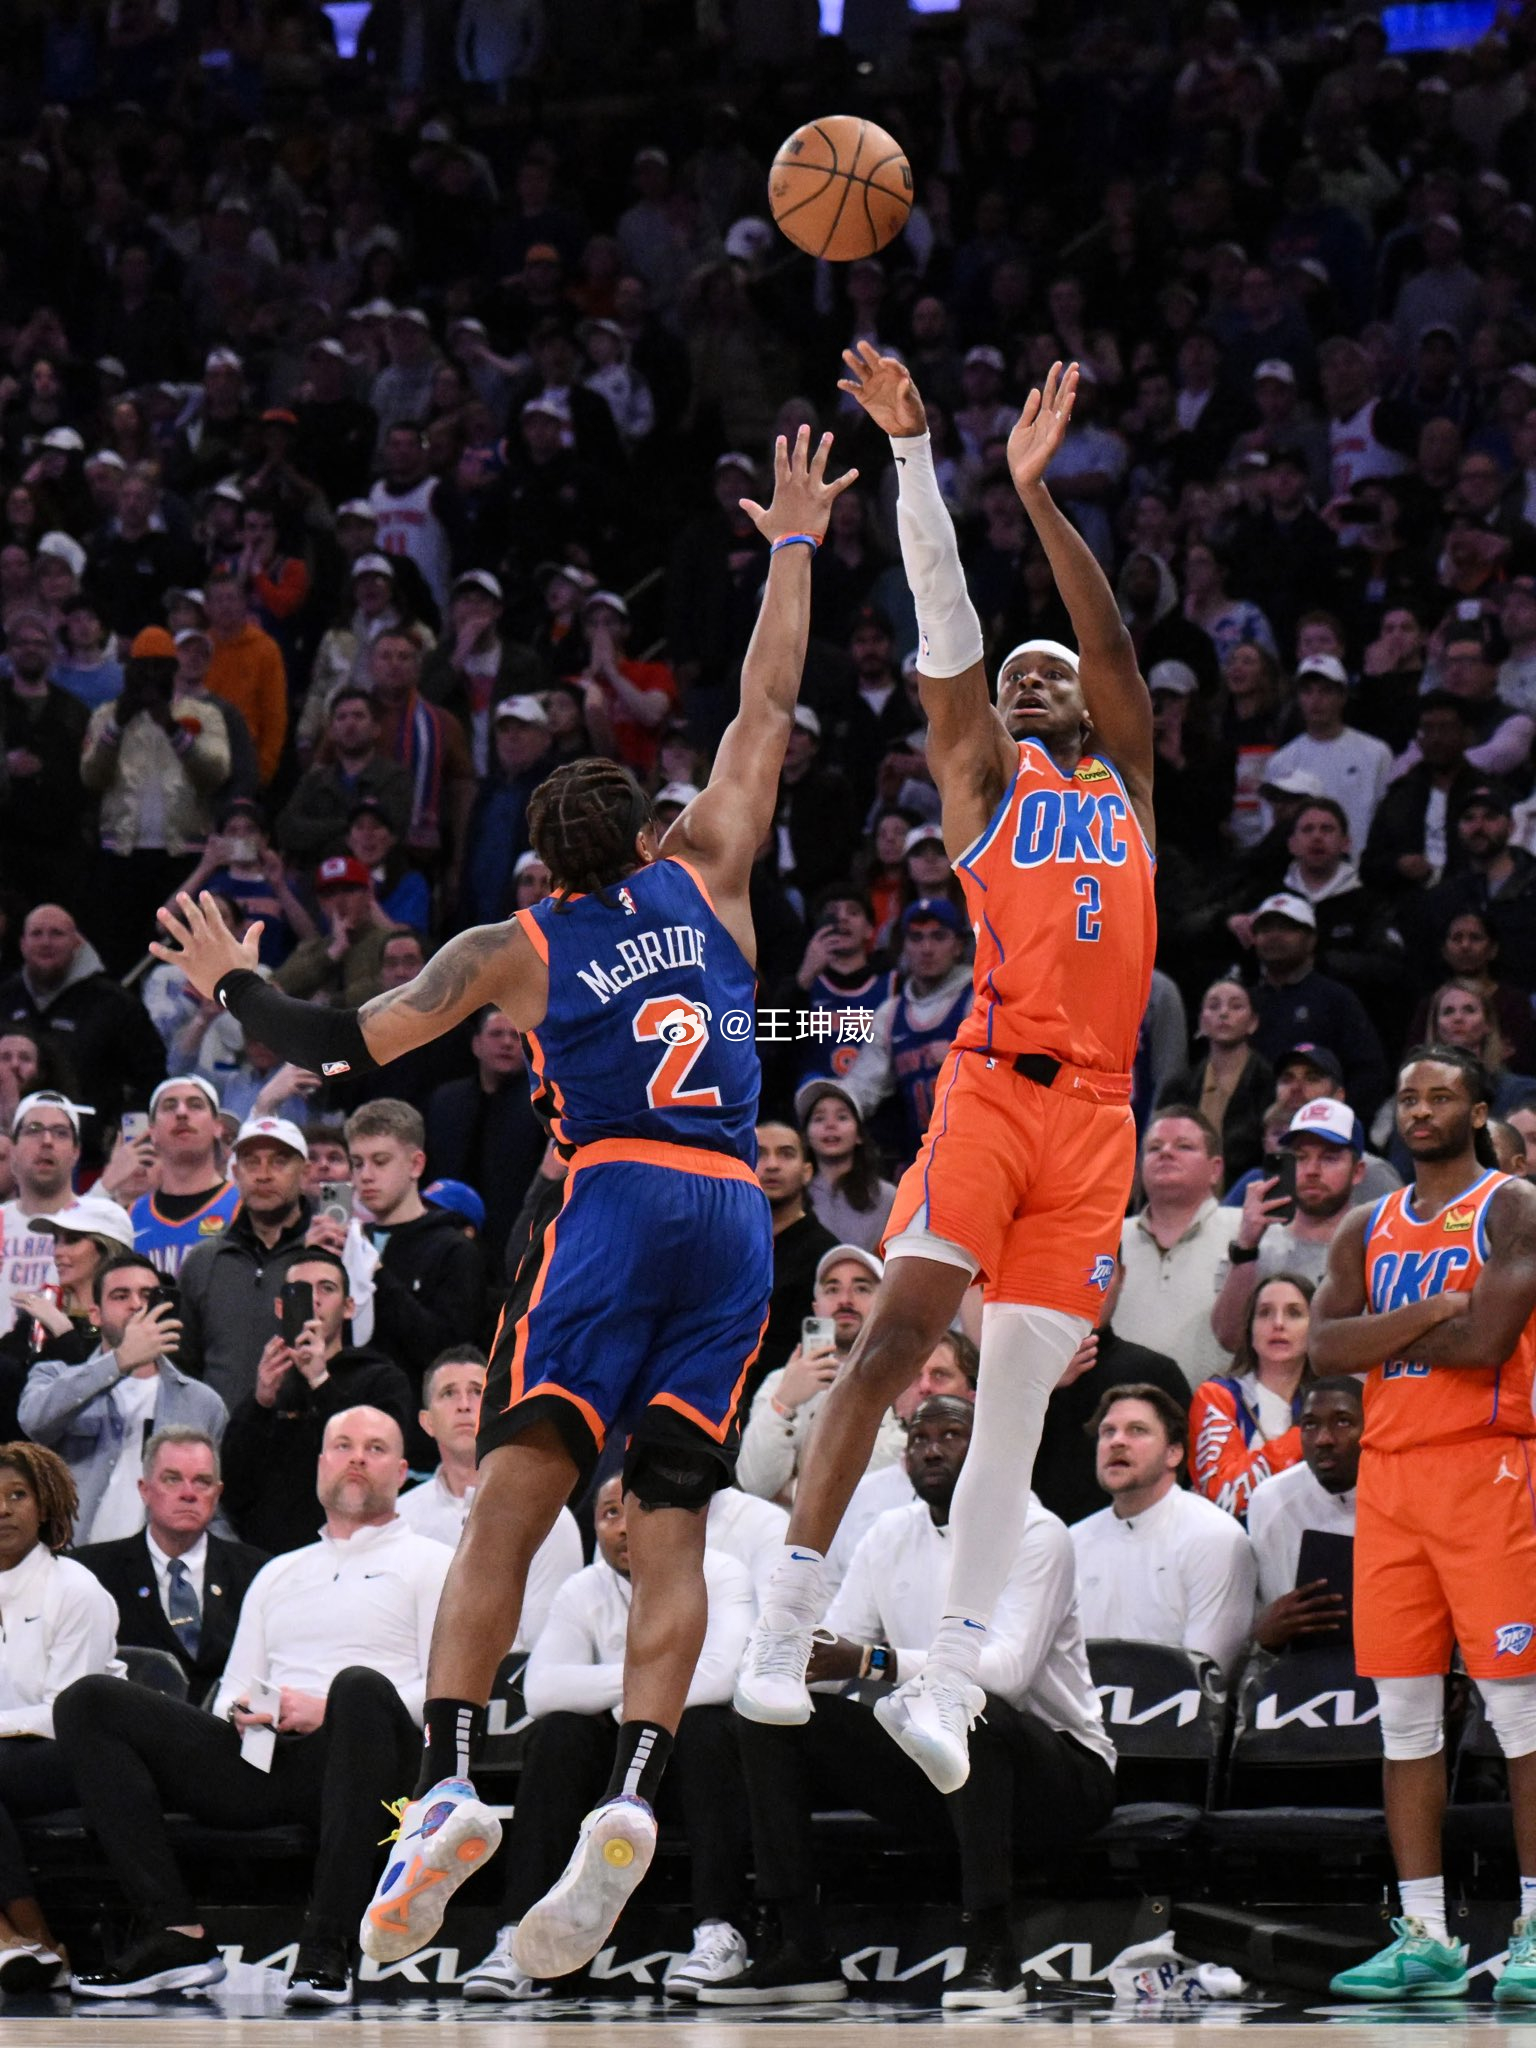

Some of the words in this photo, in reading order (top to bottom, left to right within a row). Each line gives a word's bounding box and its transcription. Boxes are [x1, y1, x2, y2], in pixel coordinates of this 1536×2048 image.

[1011, 788, 1128, 869] OKC
[1073, 875, 1102, 942] 2
[576, 926, 706, 1005] McBRIDE
[632, 993, 722, 1109] 2
[1372, 1246, 1471, 1315] OKC
[841, 1946, 967, 1982] KIA
